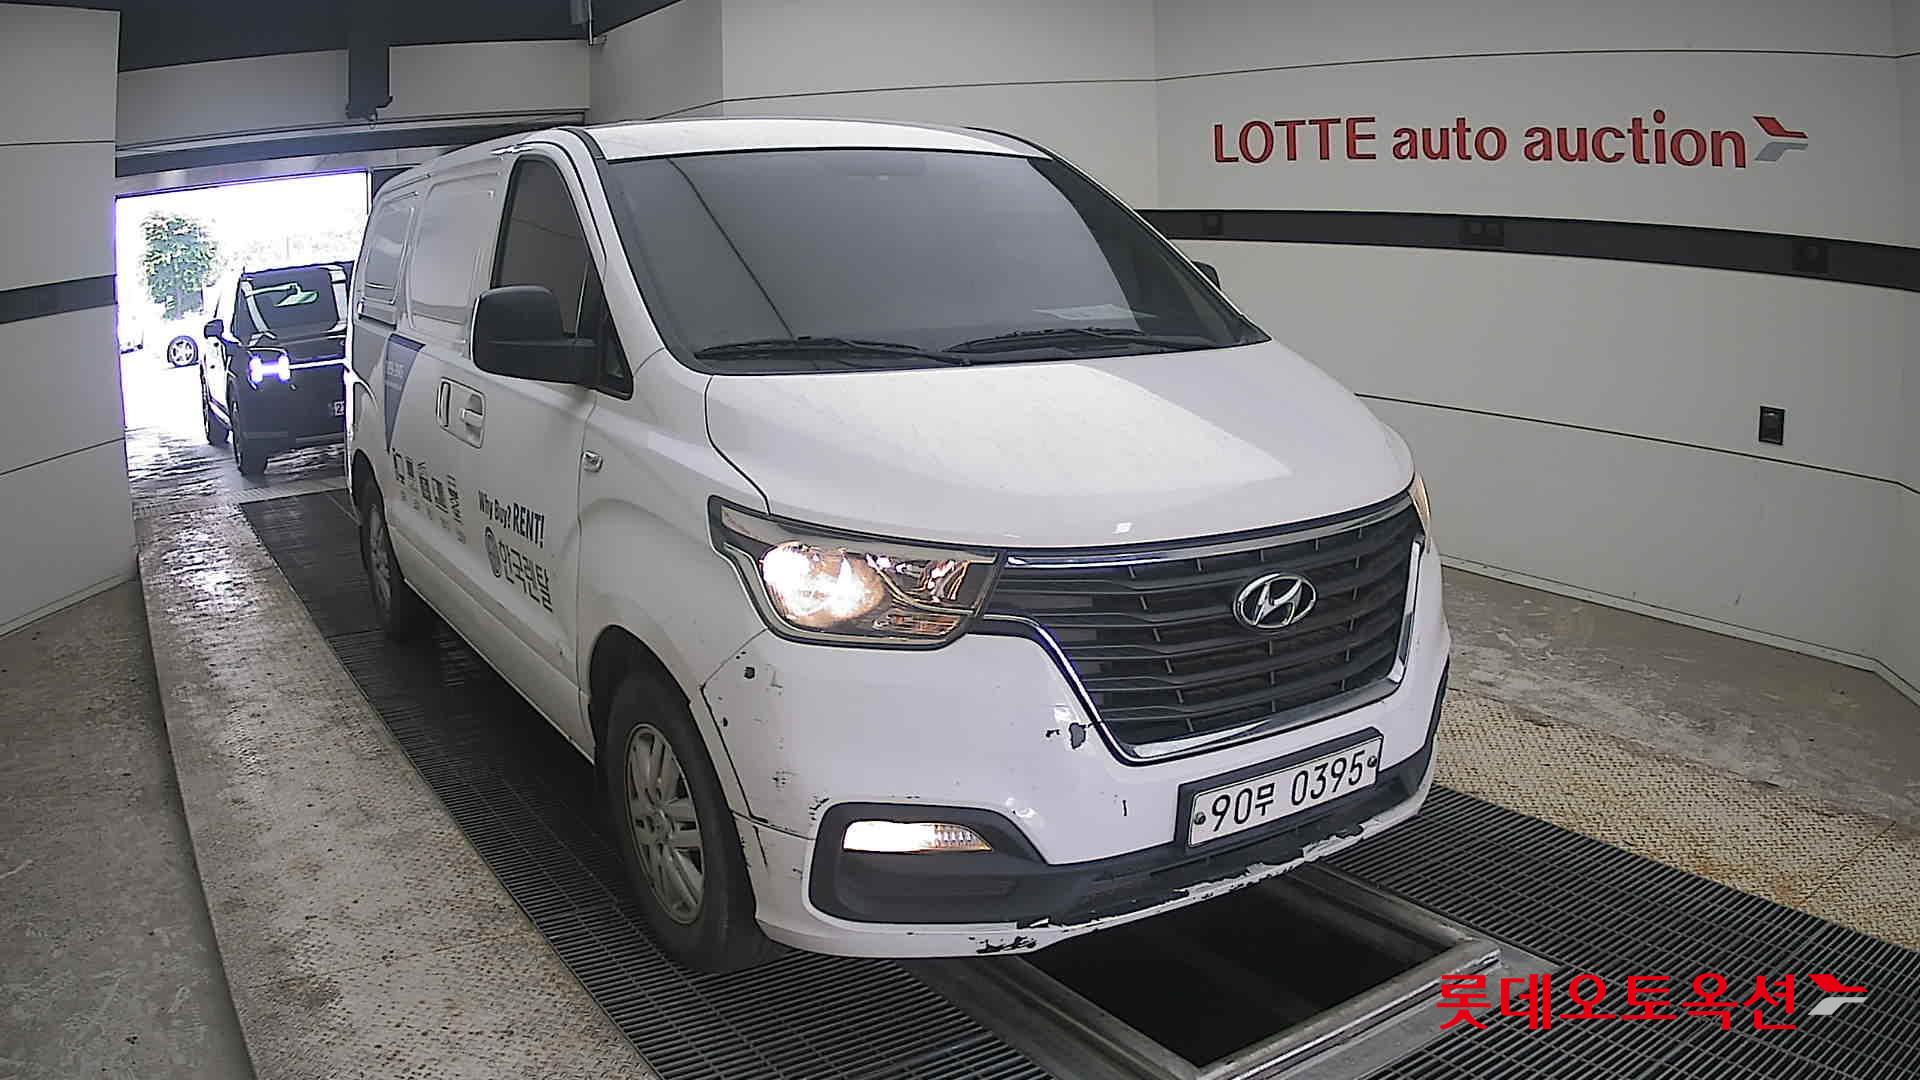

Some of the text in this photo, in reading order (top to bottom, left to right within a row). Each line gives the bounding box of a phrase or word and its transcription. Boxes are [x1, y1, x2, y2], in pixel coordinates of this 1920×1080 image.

[1213, 108, 1747, 169] LOTTE auto auction
[512, 502, 545, 550] RENT!
[1211, 749, 1366, 832] 90무 0395
